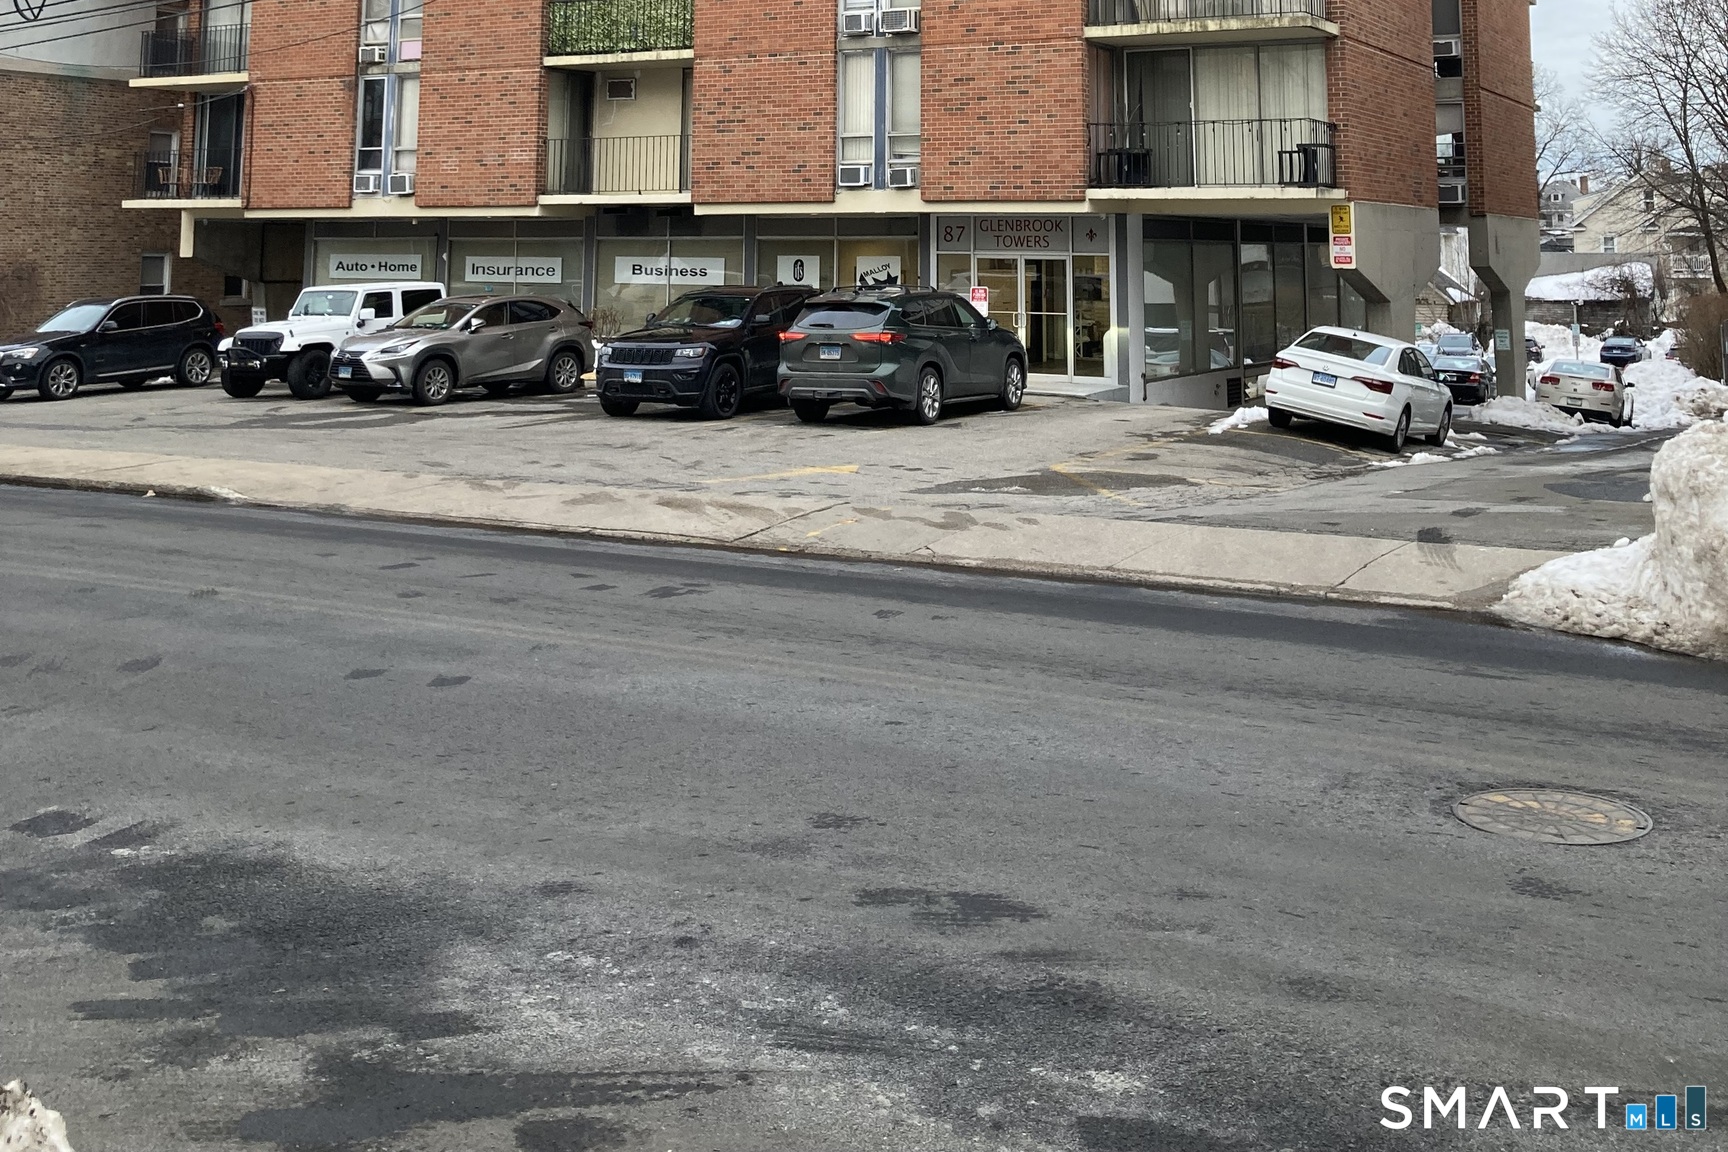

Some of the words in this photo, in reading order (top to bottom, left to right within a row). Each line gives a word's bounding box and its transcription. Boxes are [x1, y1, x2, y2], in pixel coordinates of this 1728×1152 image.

[979, 219, 1064, 233] GLENBROOK
[943, 225, 966, 243] 87
[993, 234, 1050, 248] TOWERS
[335, 260, 368, 272] Auto
[378, 260, 418, 272] Home
[471, 262, 556, 276] Insurance
[631, 264, 708, 277] Business
[863, 263, 891, 278] MALLOY
